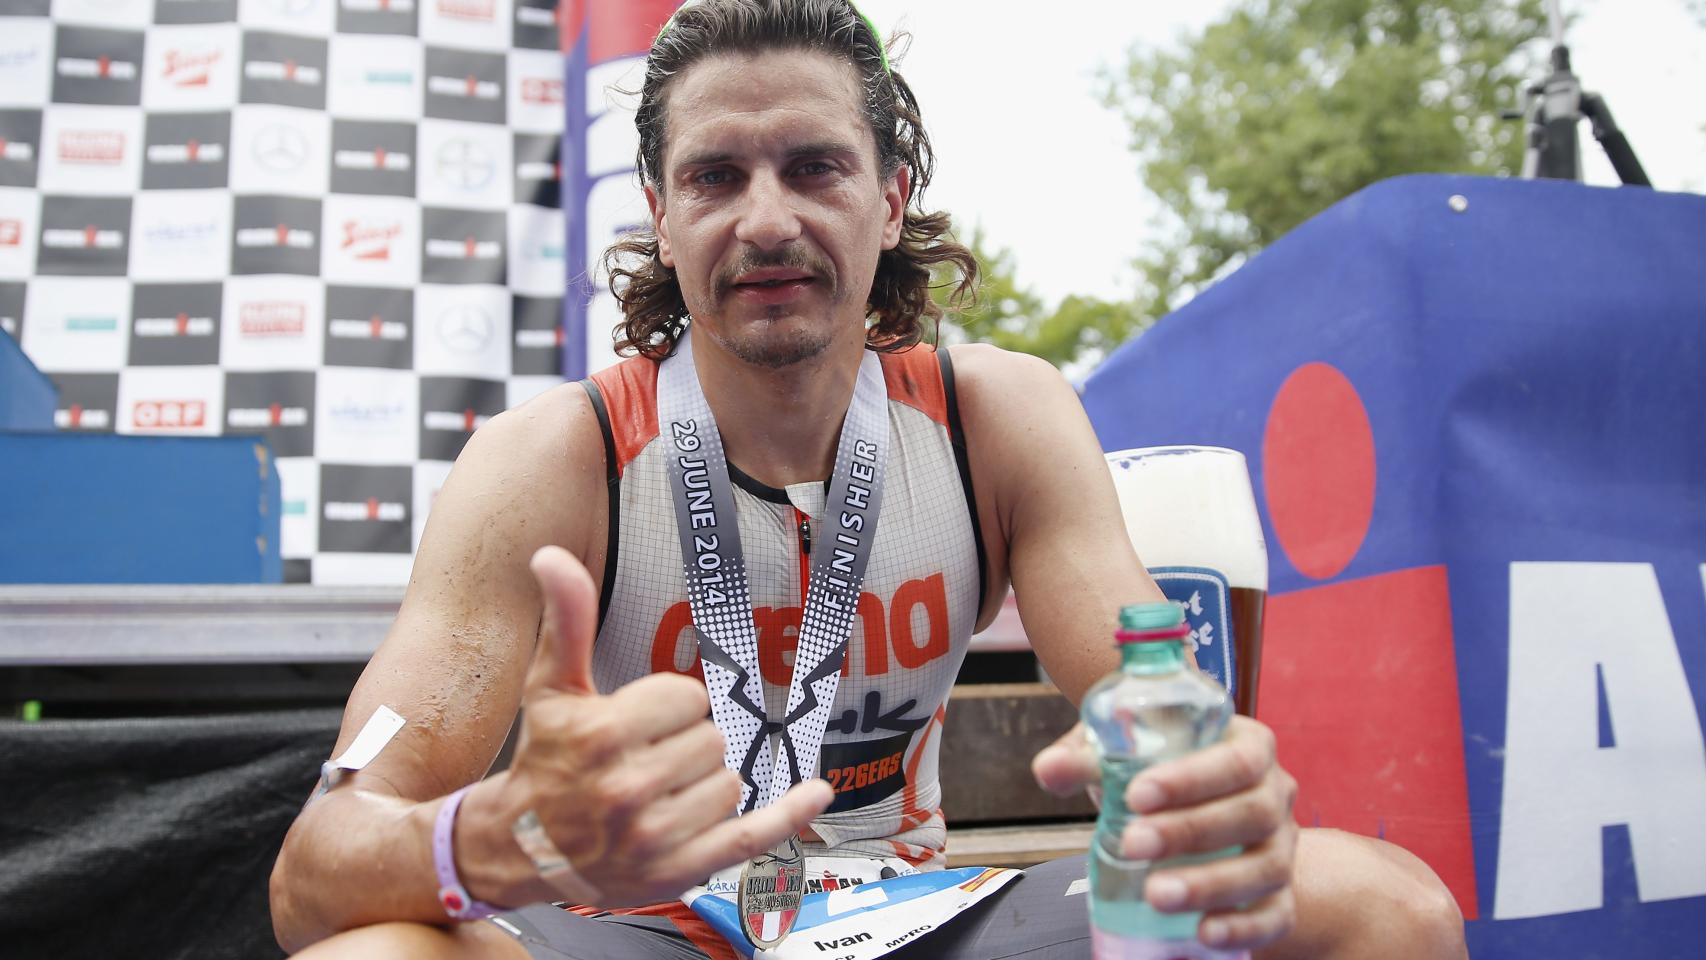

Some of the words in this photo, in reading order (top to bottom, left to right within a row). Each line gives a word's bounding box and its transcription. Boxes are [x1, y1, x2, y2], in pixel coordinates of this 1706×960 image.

[672, 419, 701, 452] 29
[679, 457, 717, 530] JUNE
[823, 438, 877, 613] FINISHER
[694, 534, 728, 607] 2014
[826, 751, 903, 795] 226ERS
[813, 932, 873, 952] Ivan
[885, 924, 932, 948] MPRO
